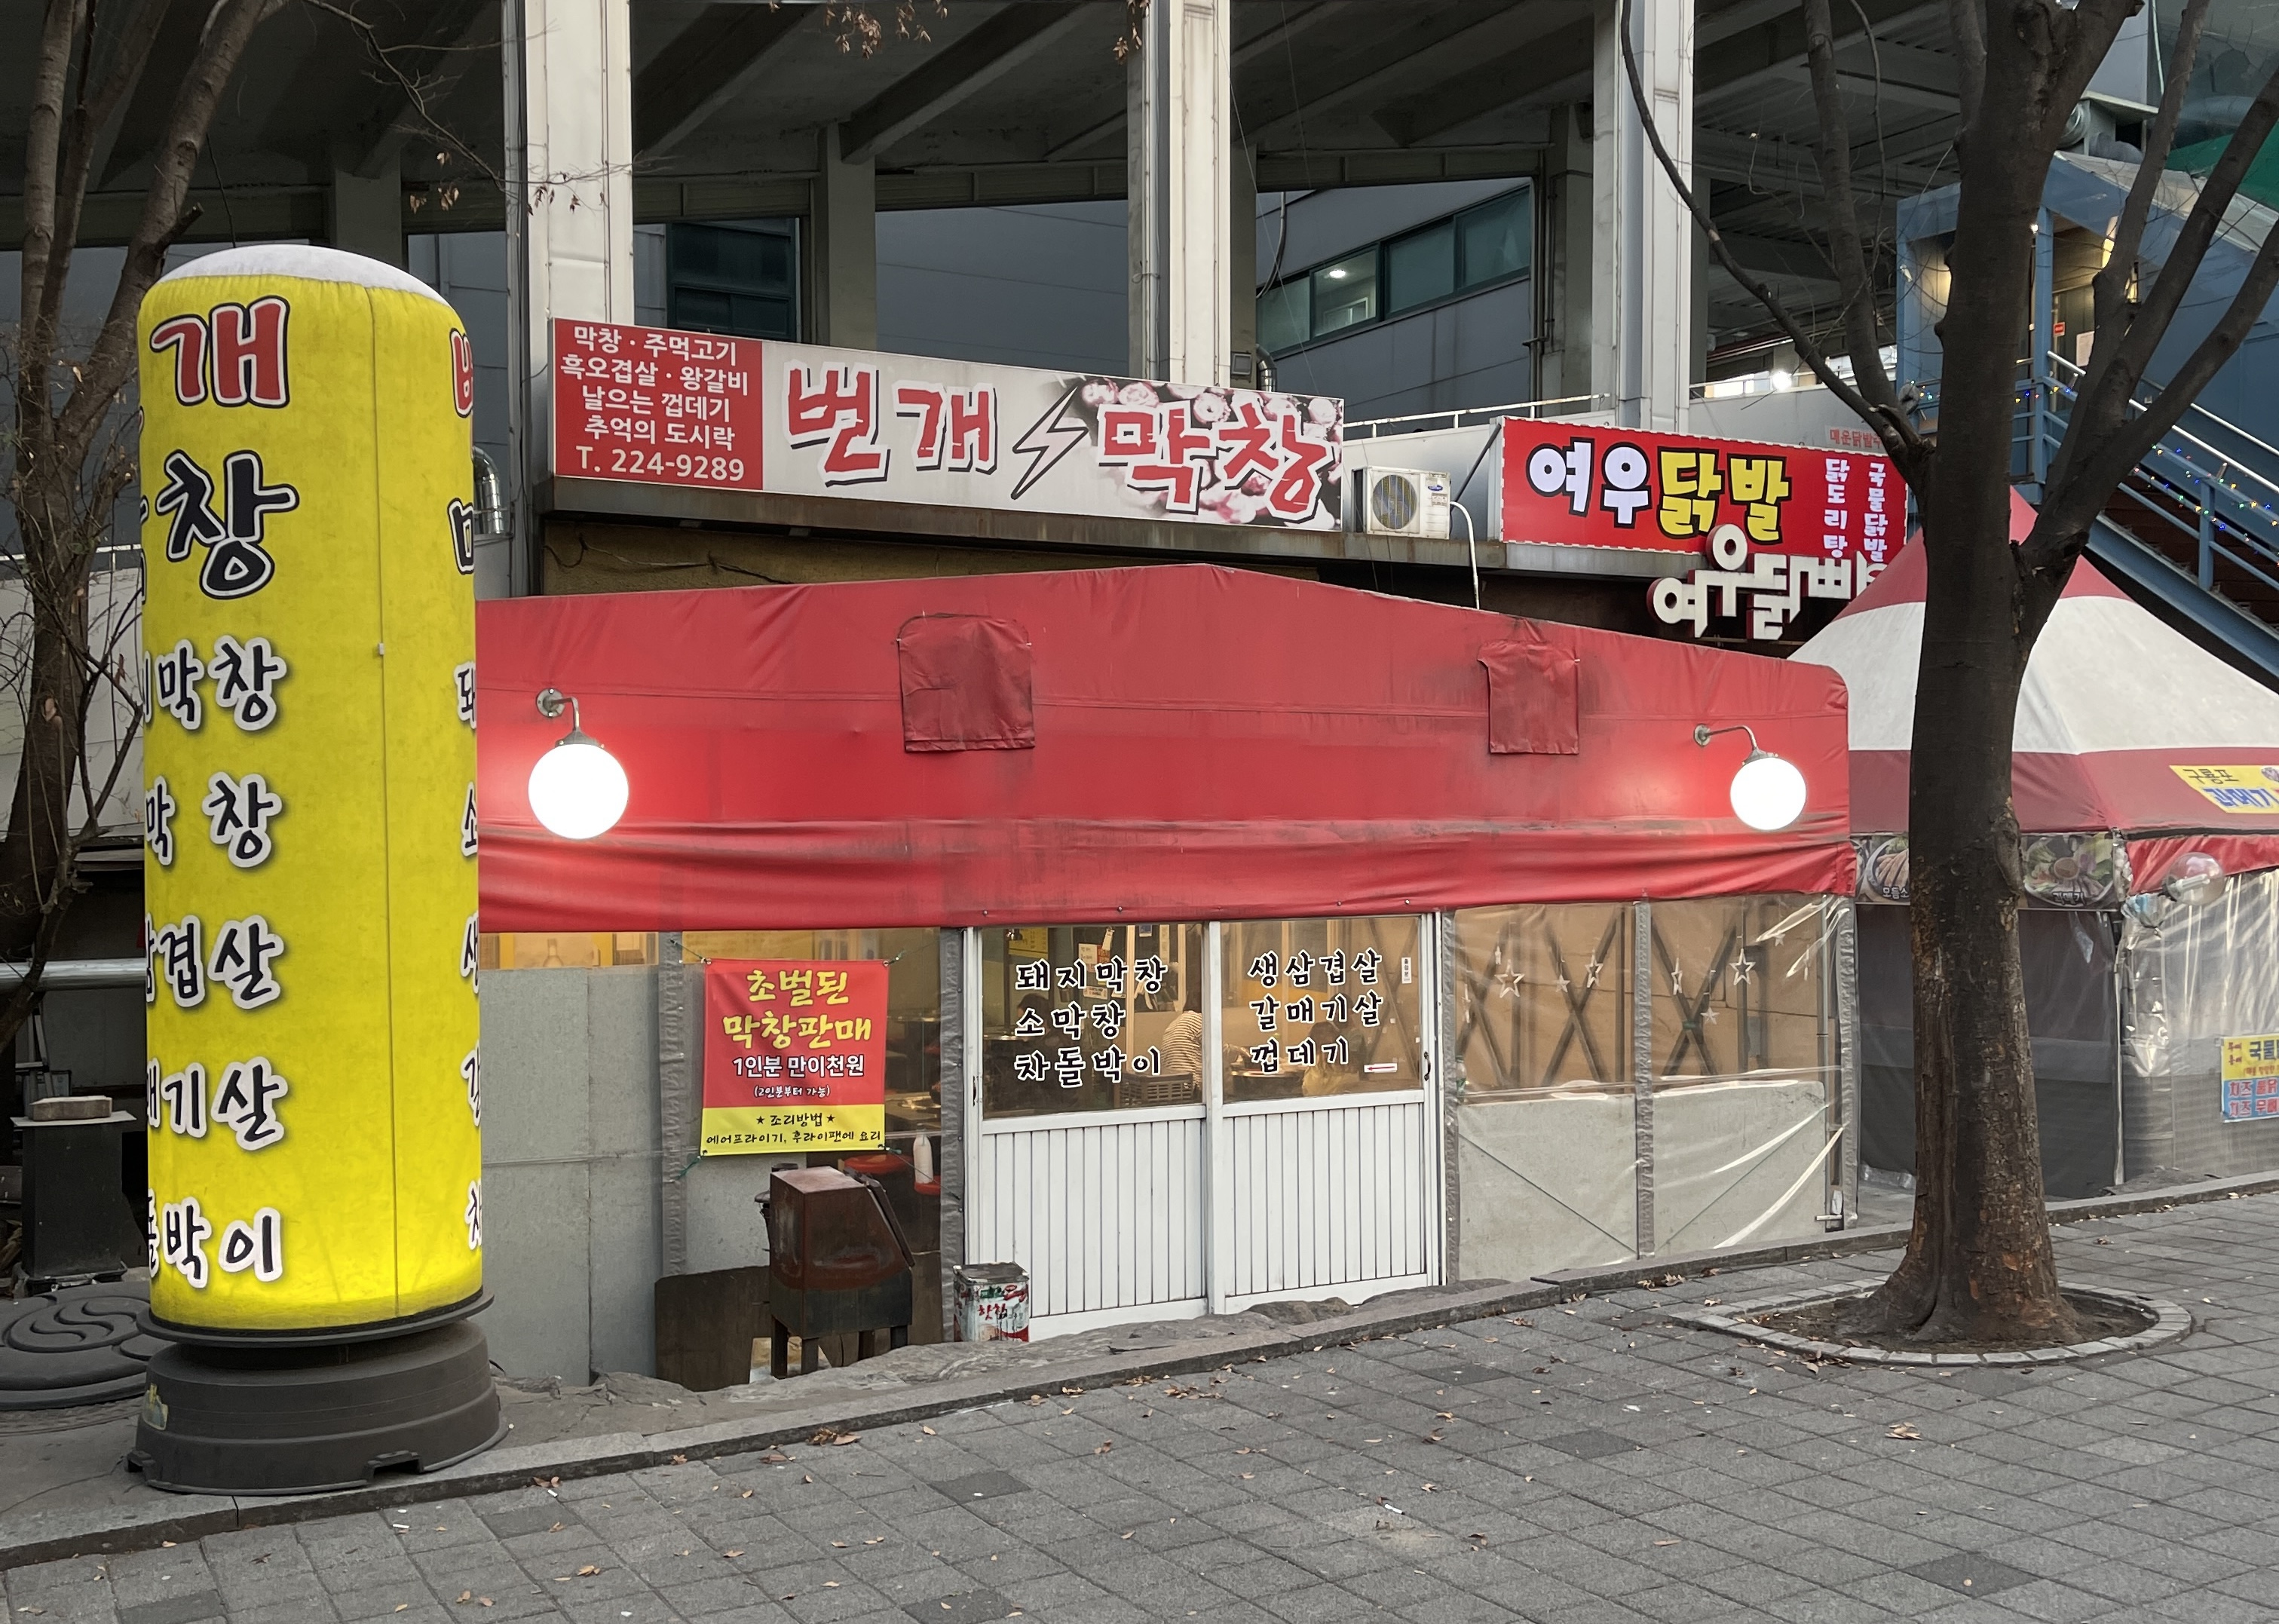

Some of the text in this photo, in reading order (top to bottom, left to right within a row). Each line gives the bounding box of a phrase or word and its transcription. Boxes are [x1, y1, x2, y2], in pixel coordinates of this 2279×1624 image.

[574, 326, 737, 366] 막창 주먹고기
[560, 354, 749, 396] 흑오겹살 왕갈비
[583, 386, 731, 423] 날으는 껍데기
[585, 416, 736, 452] 추억의 도시락
[783, 360, 1337, 523] 번개 막창
[576, 446, 745, 483] T. 224-9289
[1527, 437, 1791, 543] 여우닭발
[1823, 458, 1850, 559] 닭도리탕
[141, 449, 299, 599] 창
[1863, 462, 1888, 563] 국물닭발
[145, 637, 283, 728] 막창
[1015, 954, 1169, 994] 돼지막창
[1248, 947, 1383, 988] 생삼겹살
[746, 970, 849, 1007] 초벌된
[722, 1010, 871, 1049] 막창판매
[1015, 1000, 1126, 1040] 소막창
[1249, 990, 1383, 1032] 갈매기살
[733, 1055, 865, 1077] 1인분 만이천원
[1014, 1044, 1161, 1088] 차돌박이
[1250, 1035, 1350, 1075] 껍데기
[2249, 1040, 2279, 1061] 국물
[770, 1113, 822, 1127] 조리방법
[792, 1131, 854, 1142] 후라이팬에
[859, 1132, 881, 1141] 요리
